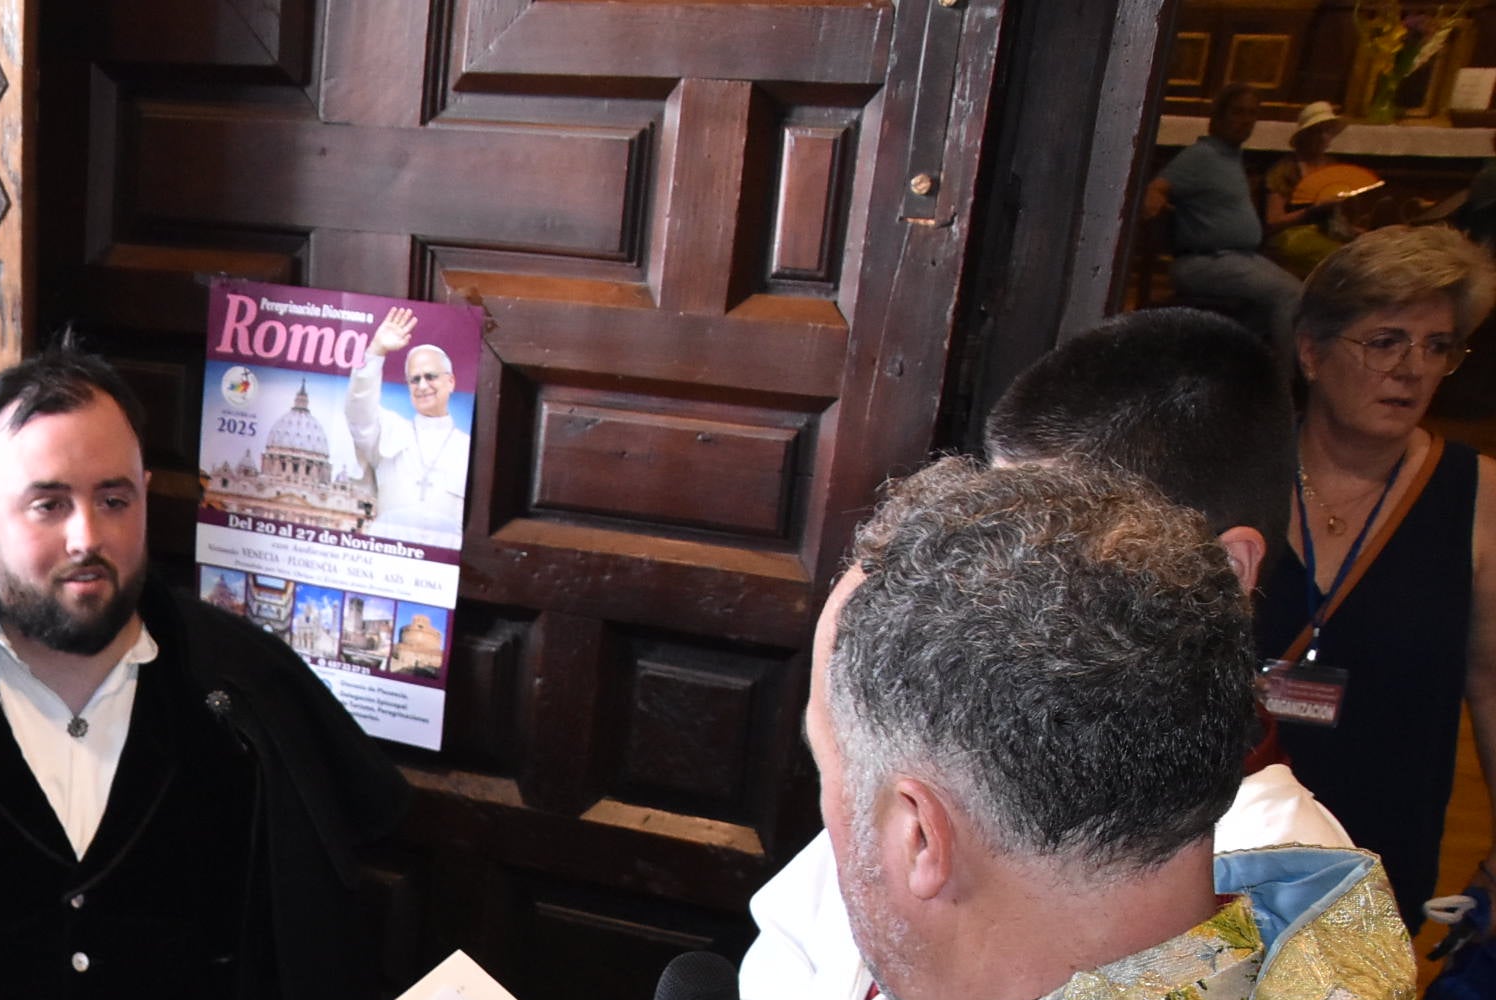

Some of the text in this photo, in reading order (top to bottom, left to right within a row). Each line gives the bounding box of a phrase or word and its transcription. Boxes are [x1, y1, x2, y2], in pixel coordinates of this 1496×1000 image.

[215, 293, 369, 369] Roma
[260, 297, 374, 324] Peregrinación Diocesana a
[217, 416, 257, 436] 2025
[228, 514, 425, 559] Del 20 al 27 de Noviembre
[241, 546, 280, 562] VENECIA
[287, 554, 339, 574] FLORENCIA
[413, 577, 443, 591] ROMA
